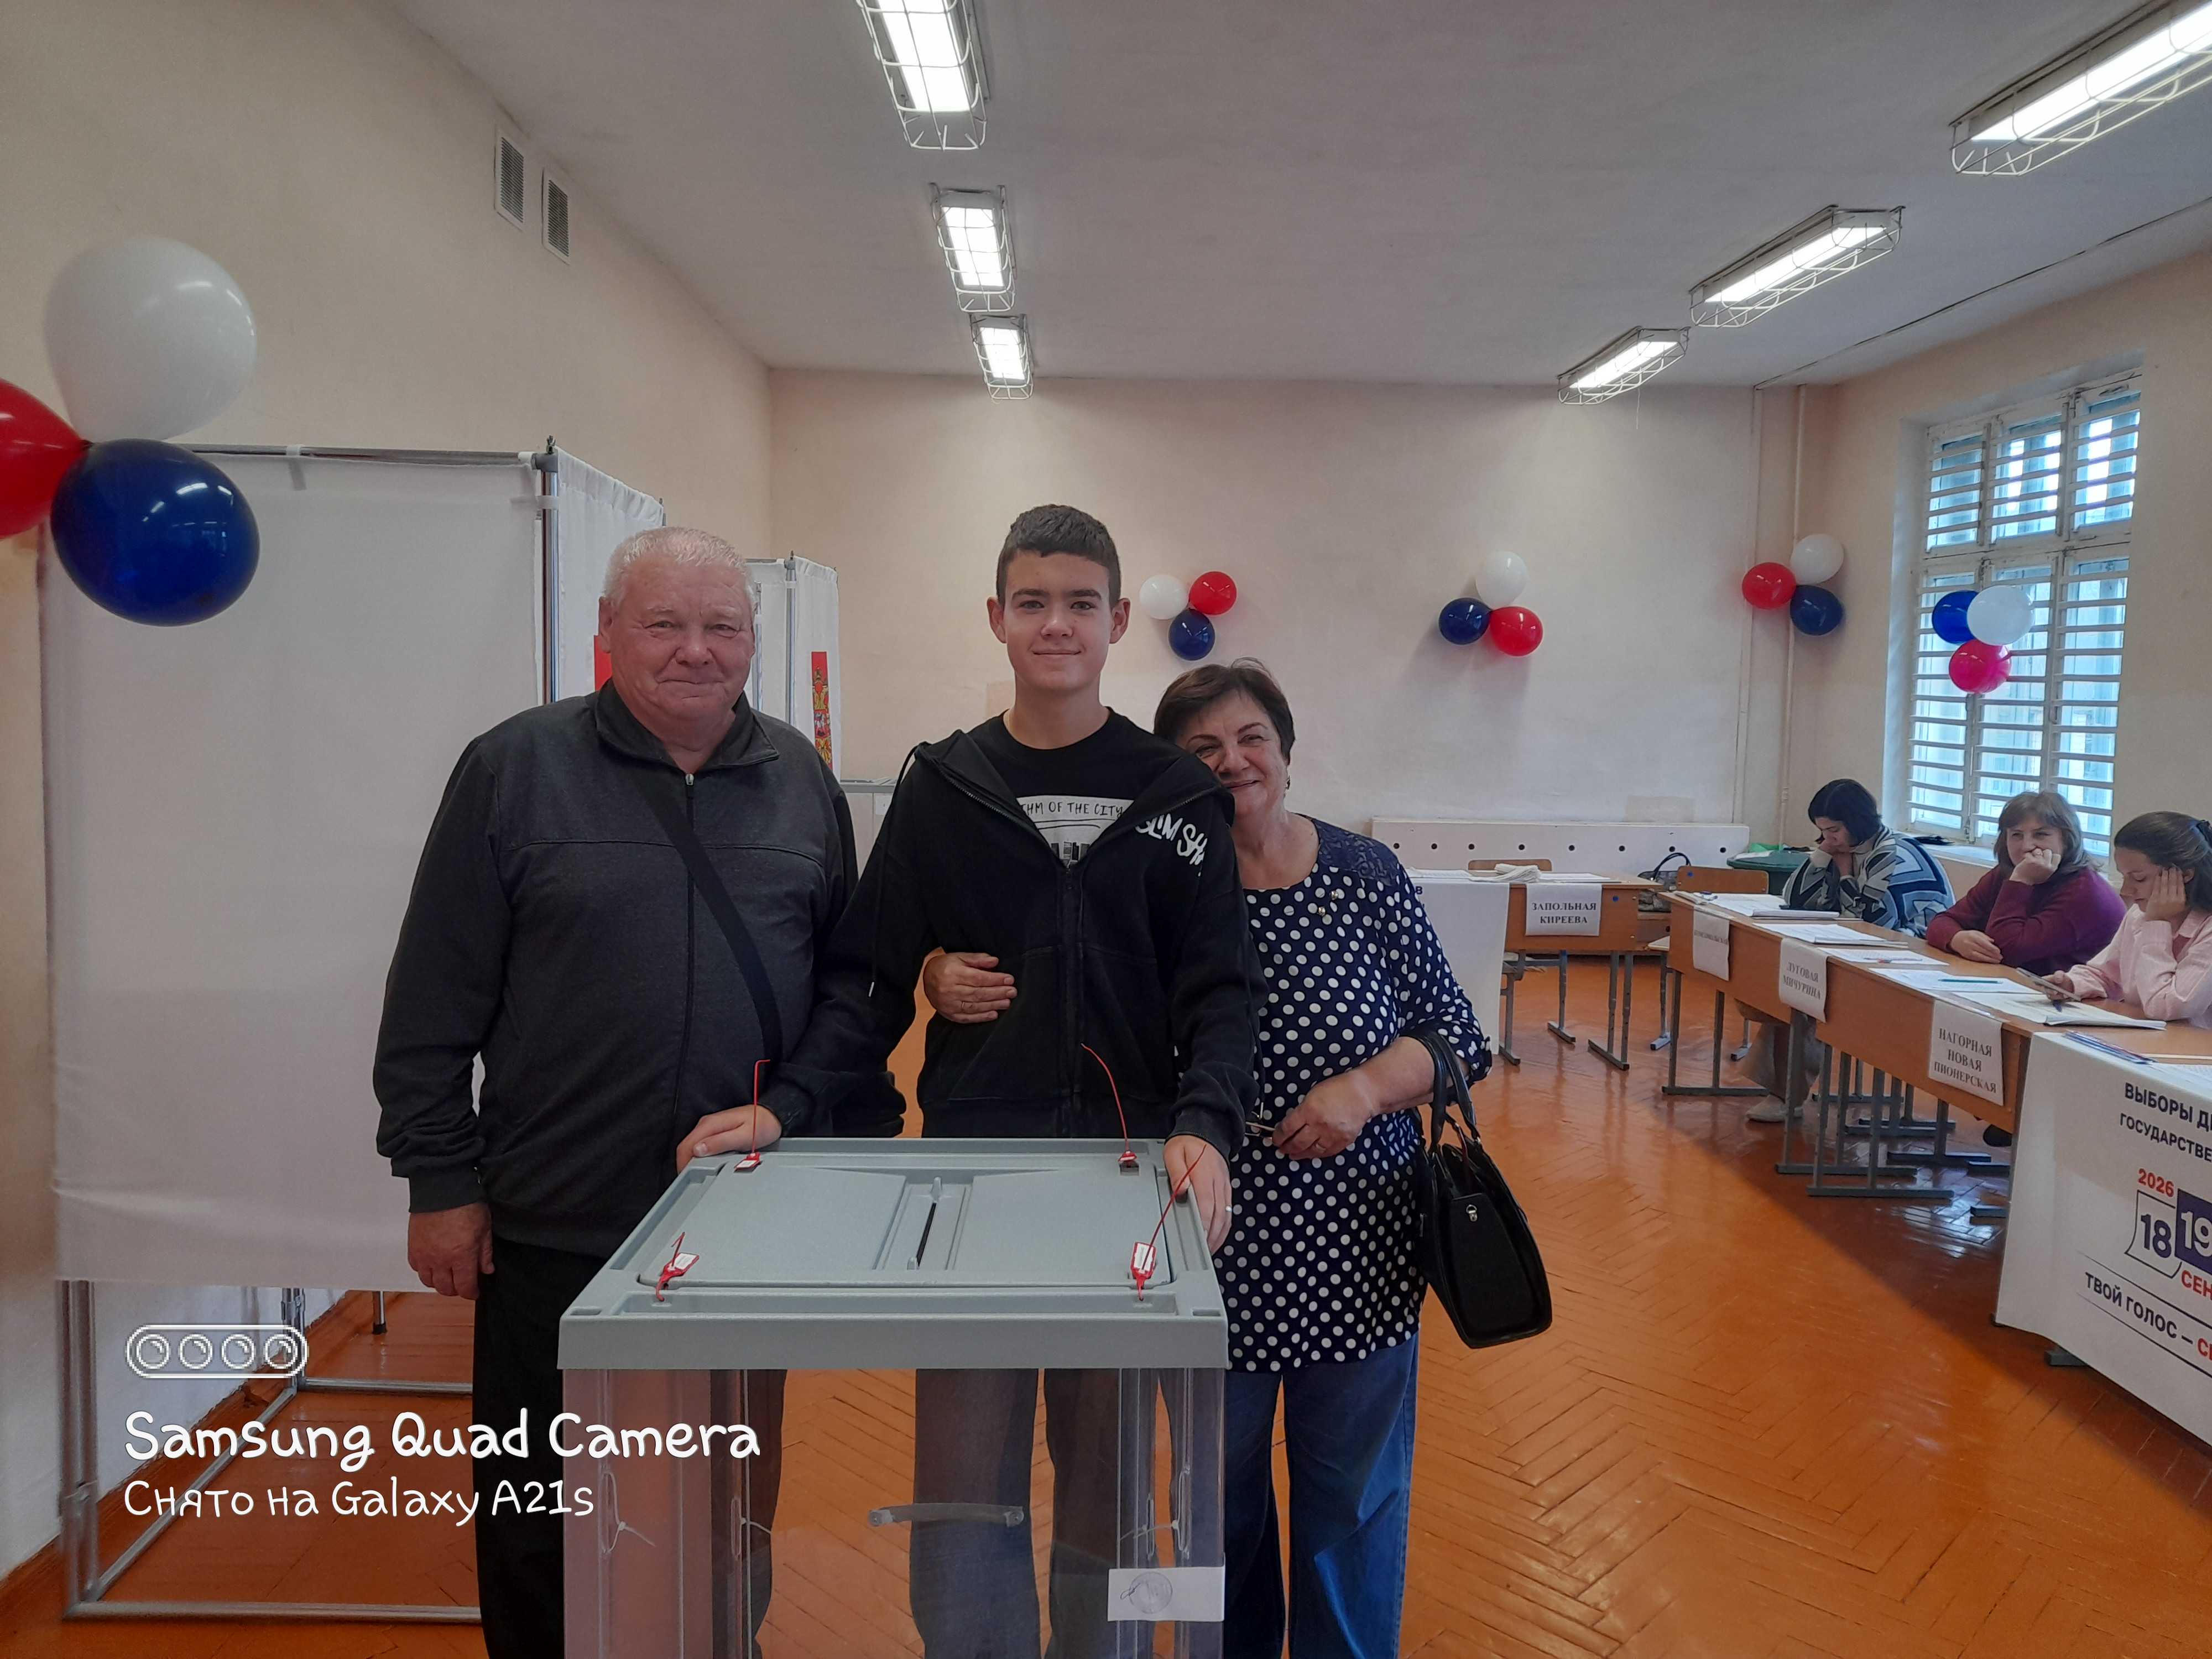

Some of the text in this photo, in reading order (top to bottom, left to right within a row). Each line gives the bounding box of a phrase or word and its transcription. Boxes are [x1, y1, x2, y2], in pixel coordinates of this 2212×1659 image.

[1048, 801, 1063, 812] OF
[1067, 802, 1089, 815] THE
[1094, 804, 1124, 818] CITY
[1531, 902, 1597, 911] ЗАПОЛЬНАЯ
[1540, 916, 1588, 924] КИРЕЕВА
[1783, 974, 1821, 1000] МИЧУРИНА
[1786, 962, 1819, 983] ЛУГОВАЯ
[1938, 1028, 1992, 1057] НАГОРНАЯ
[1948, 1048, 1982, 1072] НОВАЯ
[1934, 1061, 1996, 1093] ПИОНЕРСКАЯ
[2125, 1082, 2212, 1133] ВЫБОРЫ Д
[2120, 1112, 2212, 1162] ГОСУДАРСТВЕ
[2138, 1168, 2174, 1197] 2026
[2140, 1211, 2212, 1258] 18 19
[2085, 1271, 2122, 1307] ТВОЙ
[2126, 1296, 2178, 1339] ГОЛОС
